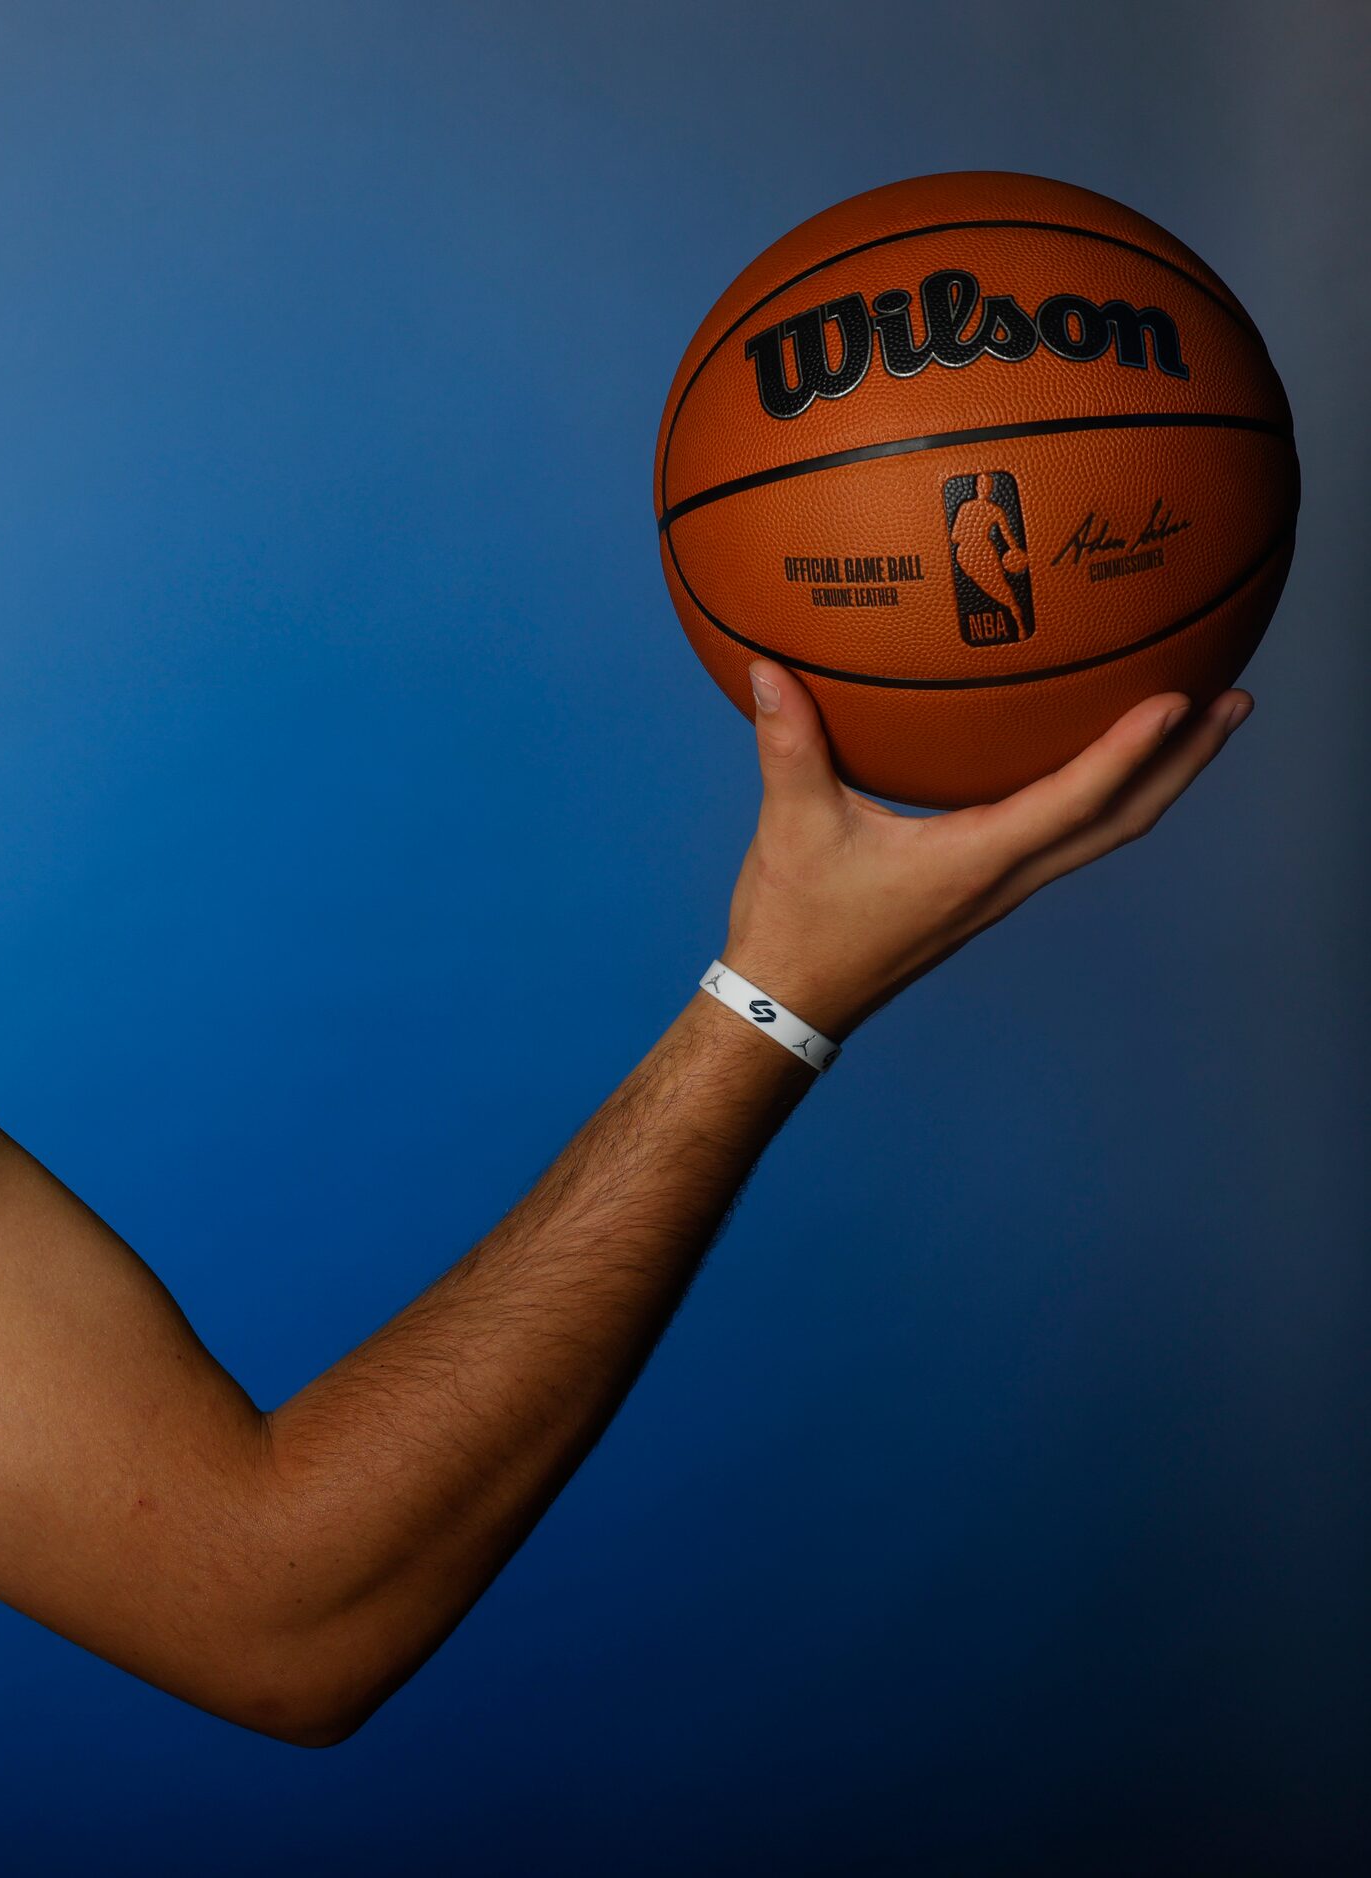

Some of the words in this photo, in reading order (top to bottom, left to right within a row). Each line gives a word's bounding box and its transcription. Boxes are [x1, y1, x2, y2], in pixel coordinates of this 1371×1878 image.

[745, 269, 1190, 420] Wilson
[784, 556, 843, 583] OFFICIAL
[844, 557, 886, 583] GAME
[887, 554, 925, 582] BALL
[1089, 548, 1165, 583] COMMISSIONER
[811, 588, 855, 607] GENUINE
[854, 587, 899, 607] LEATHER
[968, 611, 1009, 640] NBA
